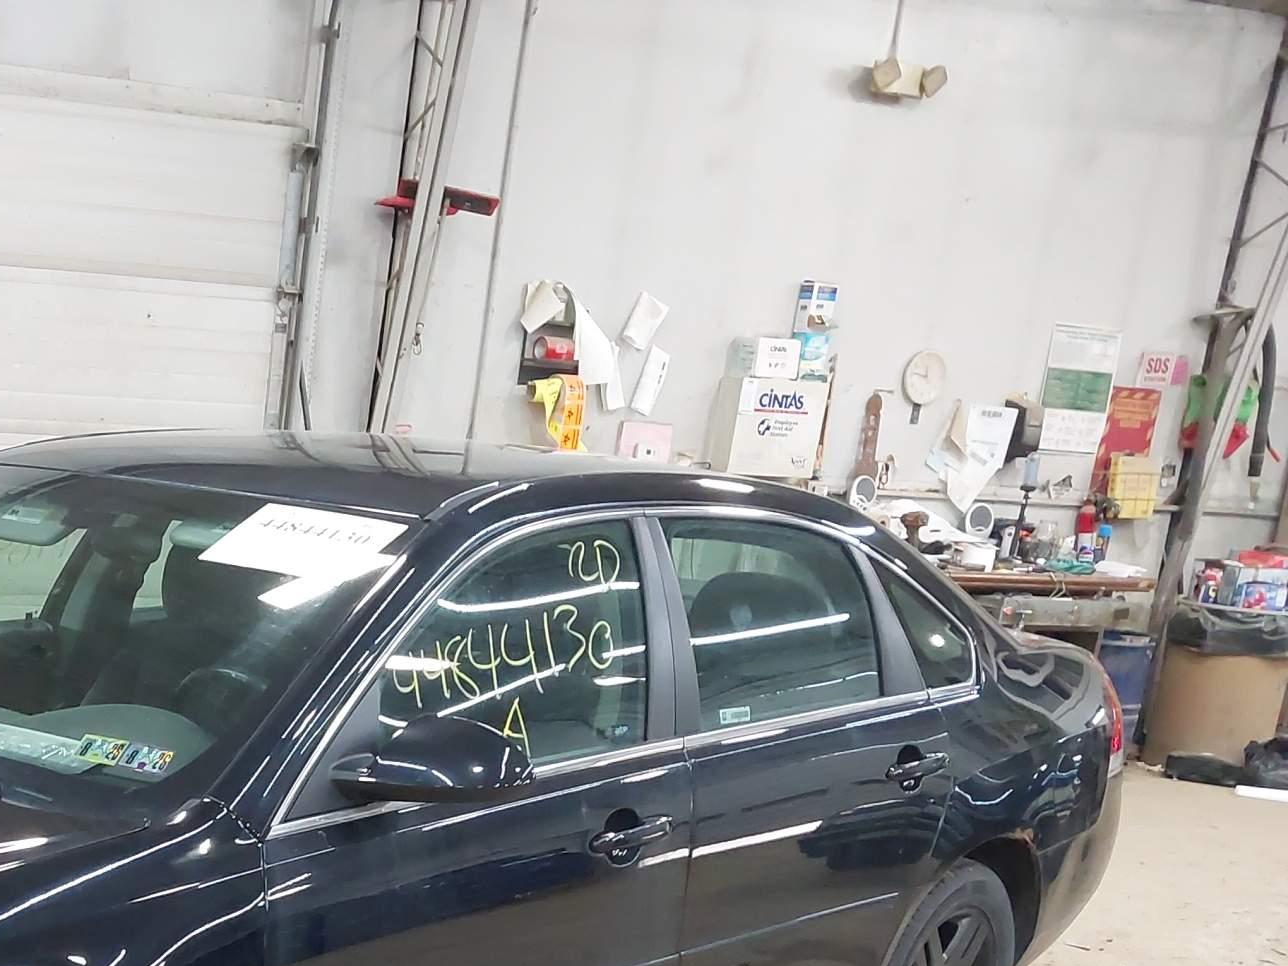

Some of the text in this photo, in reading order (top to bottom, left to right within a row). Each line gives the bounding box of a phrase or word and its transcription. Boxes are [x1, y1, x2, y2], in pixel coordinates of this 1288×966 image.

[1145, 357, 1170, 374] SDS
[759, 388, 804, 410] CINTAS
[393, 604, 614, 709] 44844130
[503, 696, 532, 763] A
